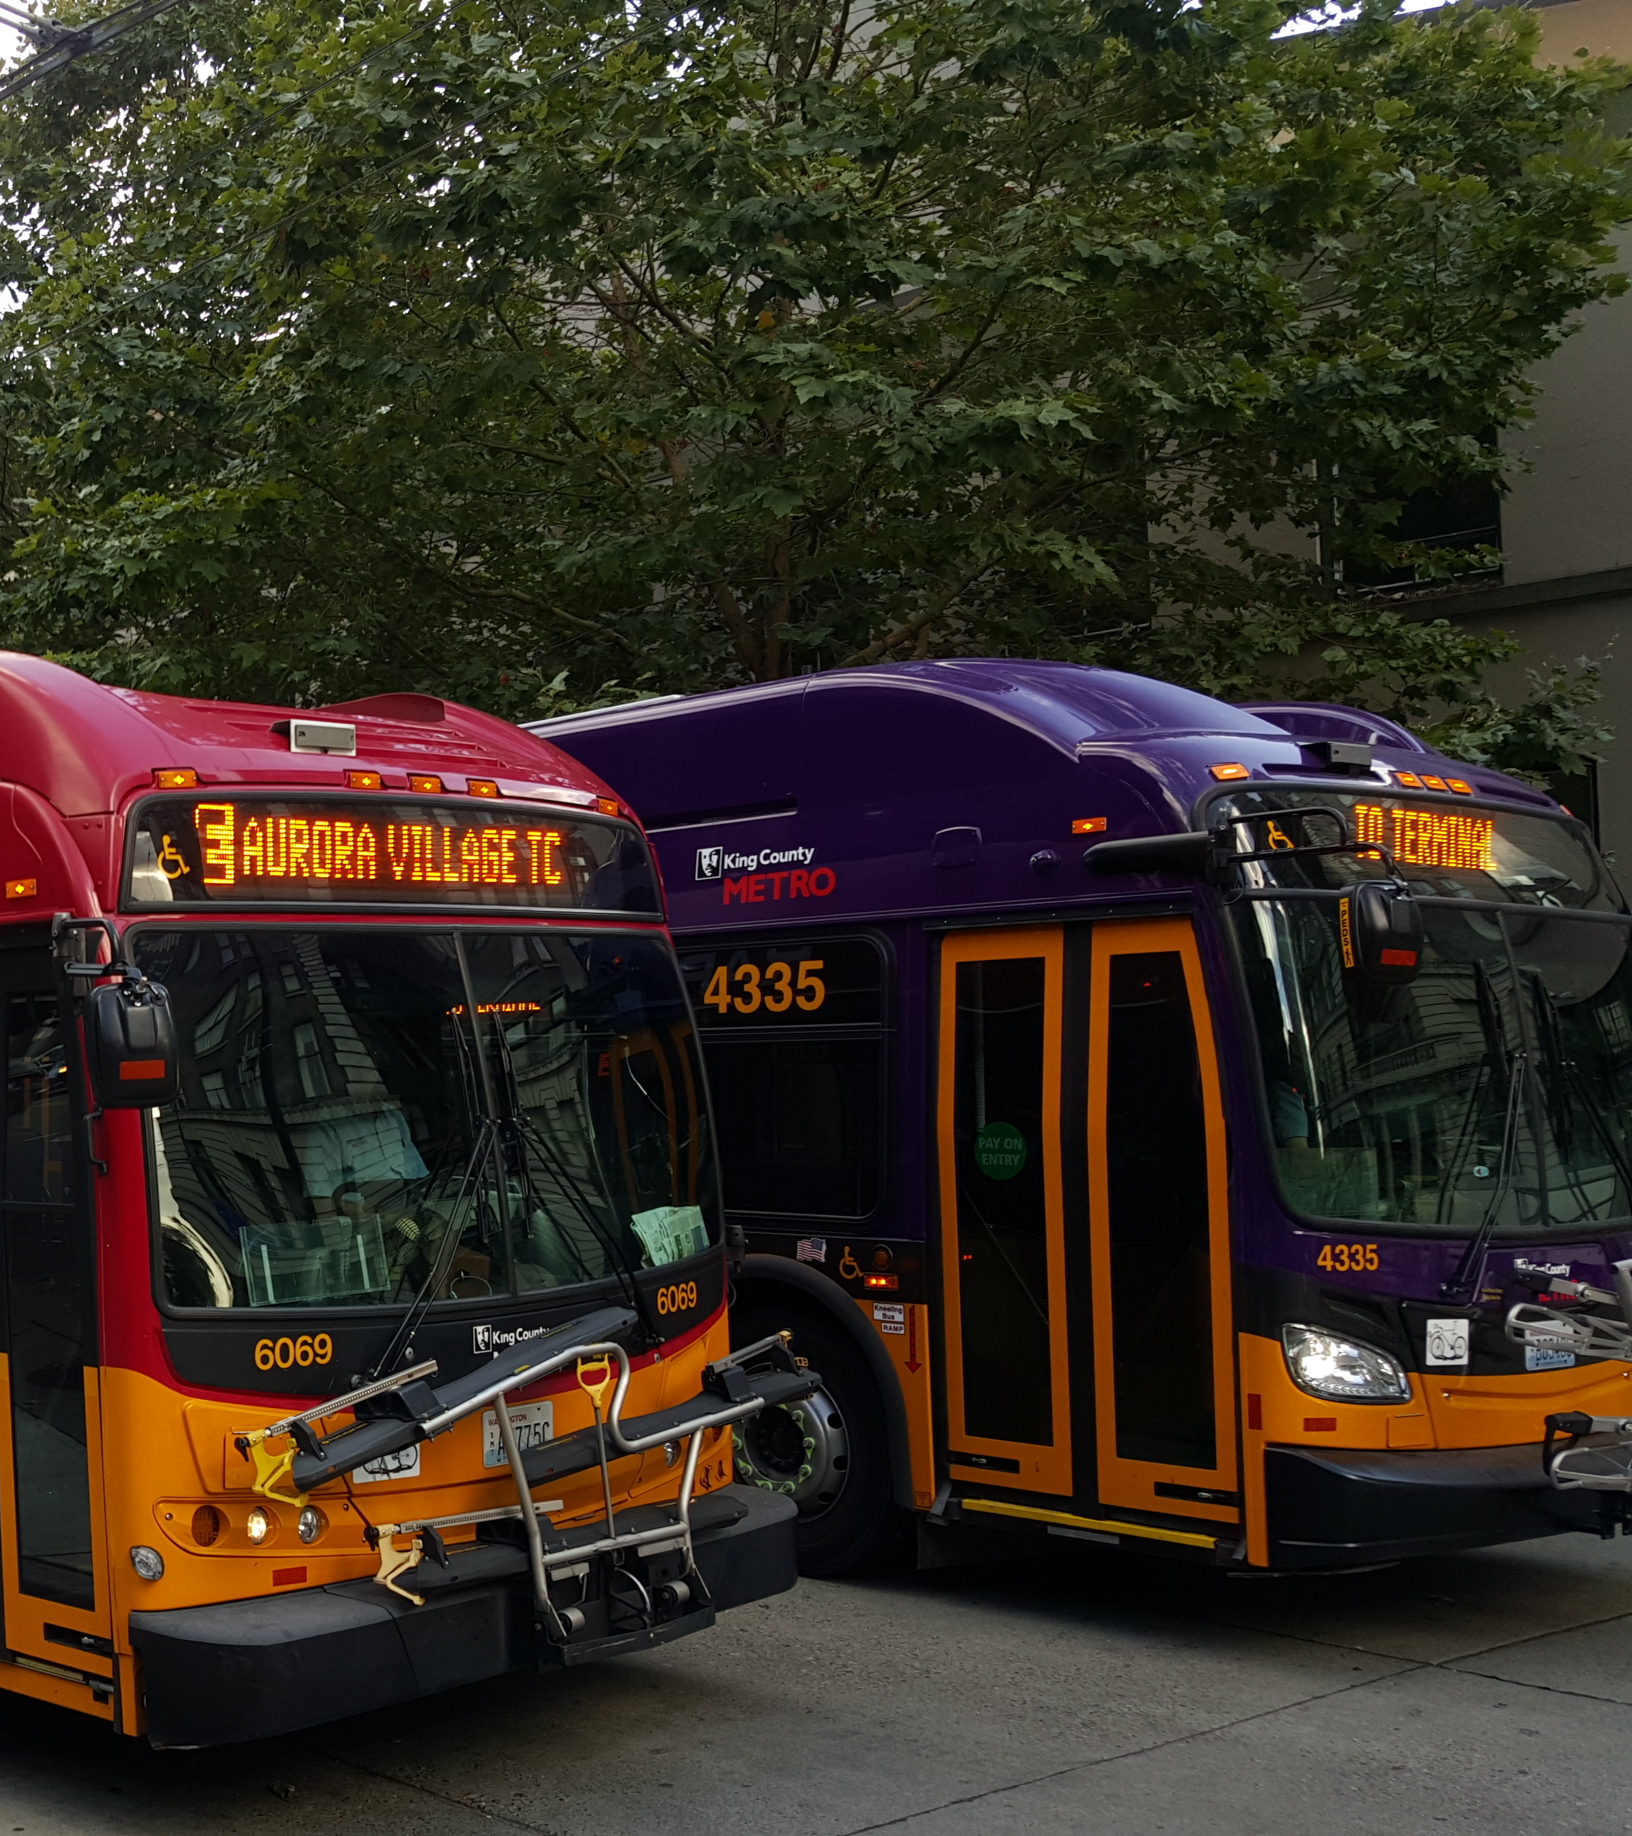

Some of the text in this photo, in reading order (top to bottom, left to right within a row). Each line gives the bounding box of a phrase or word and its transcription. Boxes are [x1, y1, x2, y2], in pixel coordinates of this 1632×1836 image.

[242, 816, 377, 880] AURORA
[387, 823, 517, 884] VILLAGE
[526, 831, 563, 885] TC
[1354, 805, 1497, 871] TO TERMINAL
[723, 846, 815, 871] King County
[722, 866, 836, 905] METRO
[704, 960, 825, 1014] 4335
[978, 1137, 1023, 1150] PAY ON
[982, 1153, 1020, 1166] ENTRY
[1317, 1244, 1379, 1271] 4335
[657, 1281, 697, 1315] 6069
[874, 1304, 903, 1315] Kneeling
[882, 1312, 895, 1320] Bus
[883, 1324, 904, 1332] RAMP
[493, 1330, 515, 1346] King
[254, 1332, 333, 1371] 6069
